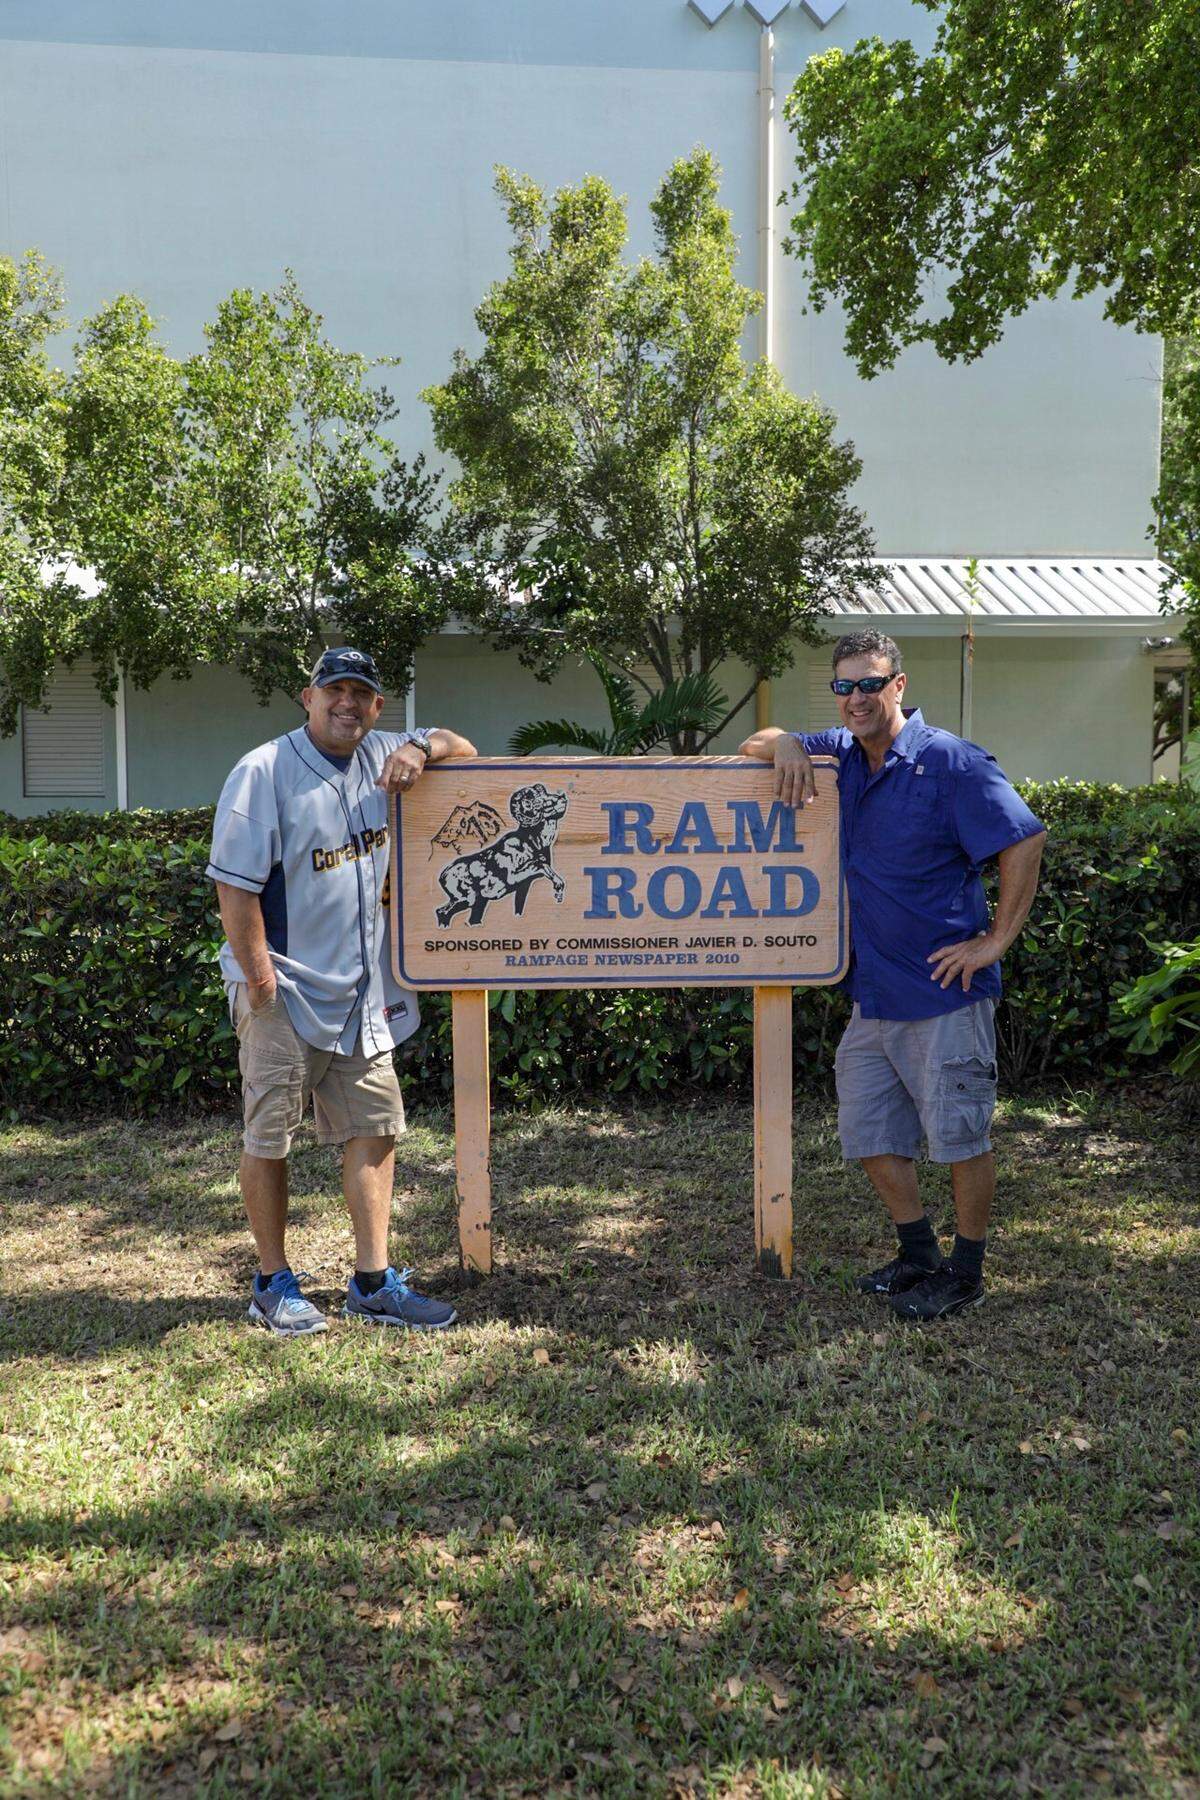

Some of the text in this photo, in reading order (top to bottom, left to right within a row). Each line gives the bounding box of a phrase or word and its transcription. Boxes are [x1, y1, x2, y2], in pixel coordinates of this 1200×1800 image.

[311, 817, 389, 872] Coral Par
[600, 800, 804, 855] RAM
[583, 865, 820, 920] ROAD
[424, 935, 817, 952] SPONSORED BY COMMISSIONER JAVIER D. SOUTO
[505, 953, 740, 967] RAMPAGE NEWSPAPER 2010
